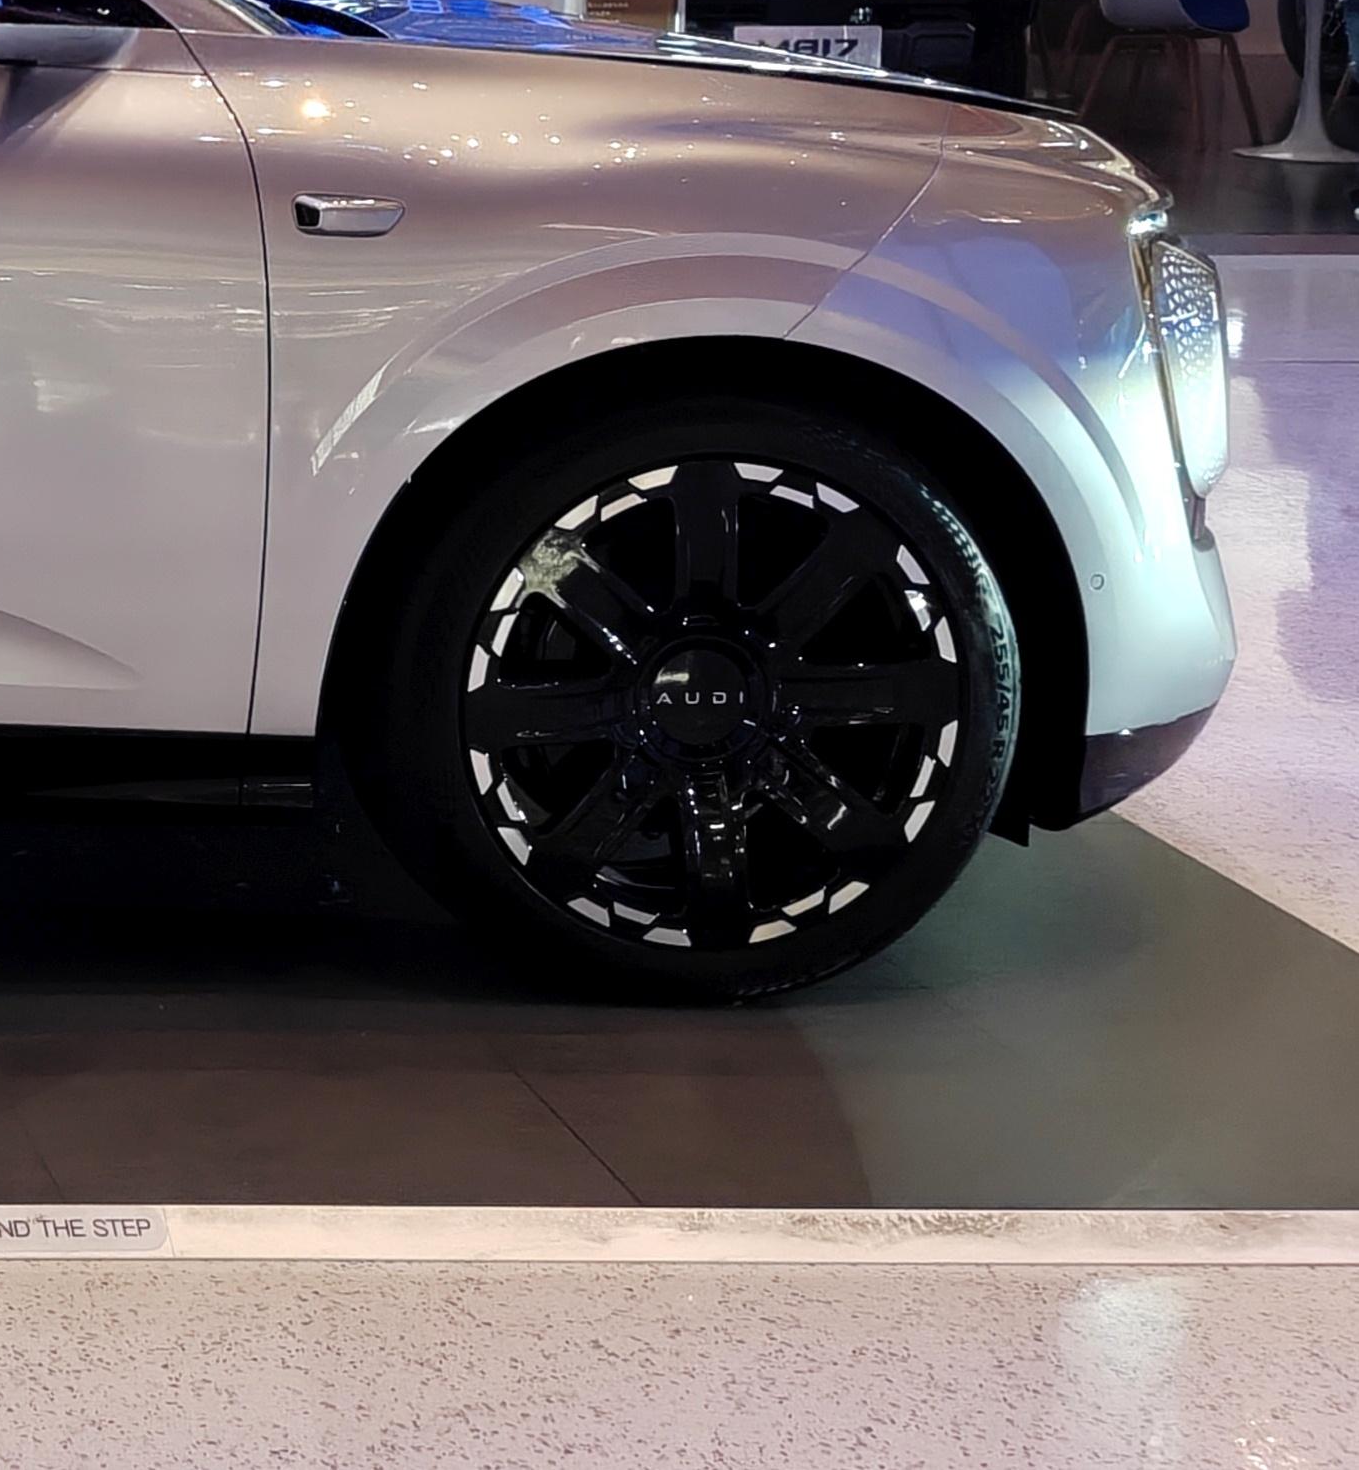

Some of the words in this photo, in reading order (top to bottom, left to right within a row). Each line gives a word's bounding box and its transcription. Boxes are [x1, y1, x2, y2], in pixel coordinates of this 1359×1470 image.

[655, 691, 745, 705] AUDI
[38, 1218, 85, 1238] THE
[92, 1218, 151, 1237] STEP
